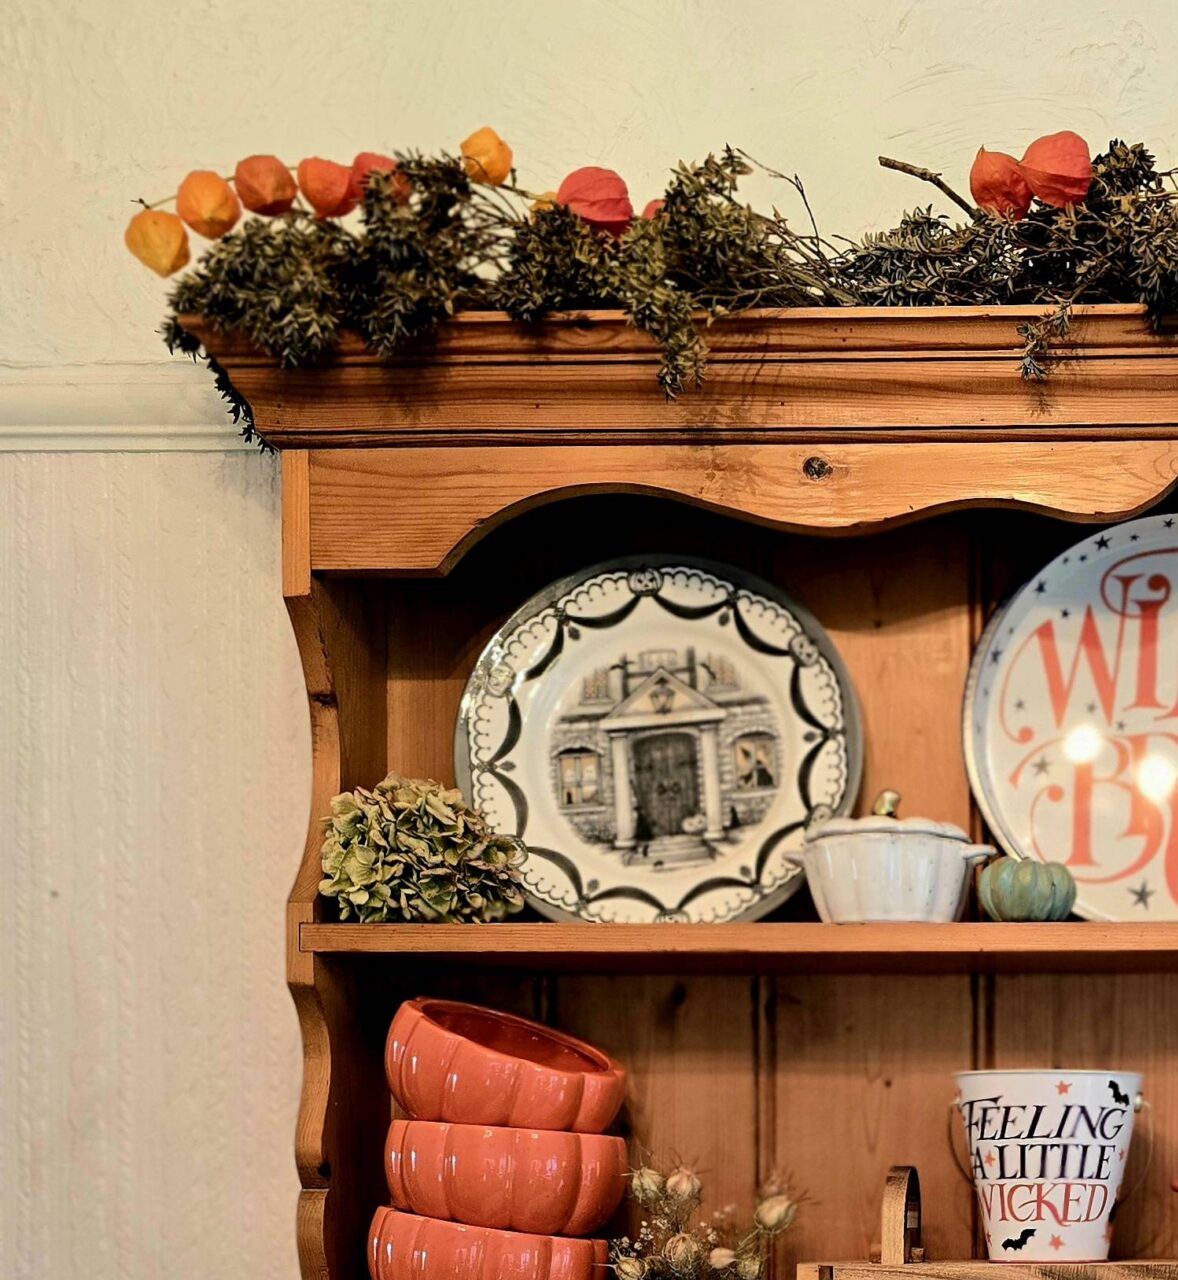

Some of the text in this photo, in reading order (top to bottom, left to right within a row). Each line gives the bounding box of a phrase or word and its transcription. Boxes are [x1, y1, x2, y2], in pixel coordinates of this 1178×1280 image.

[961, 1095, 1127, 1156] FEELING
[973, 1143, 1116, 1181] A LITTLE
